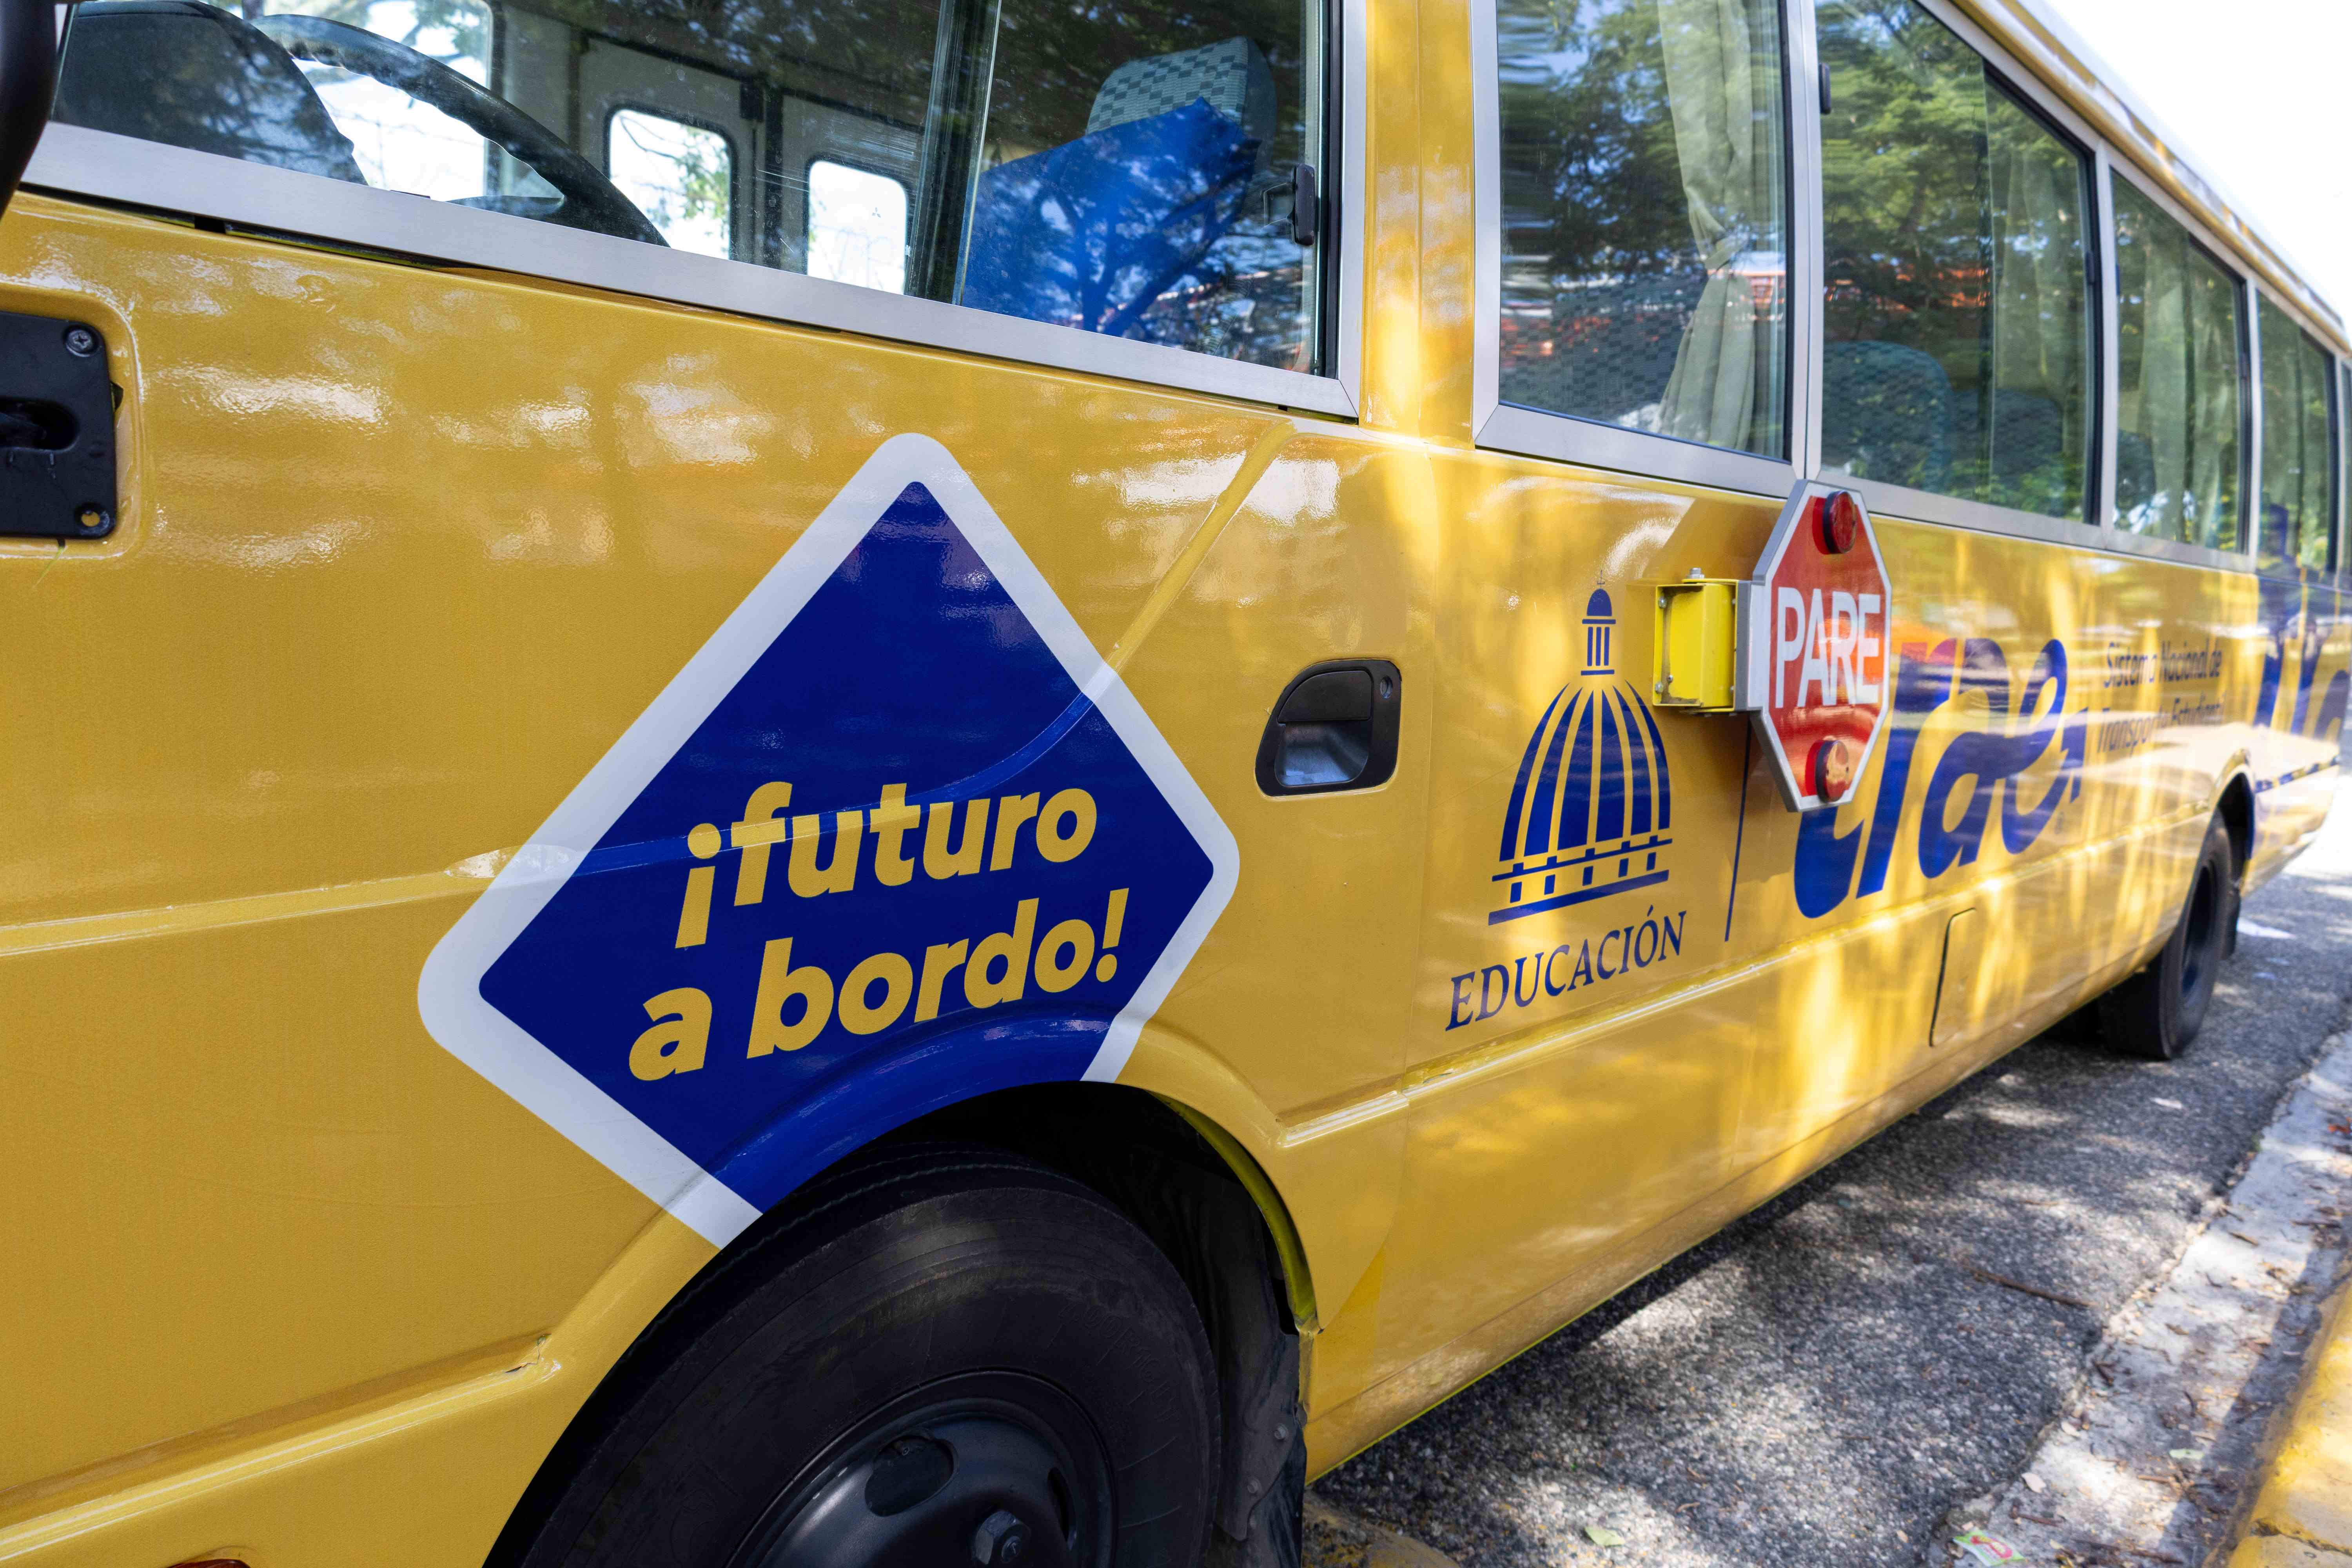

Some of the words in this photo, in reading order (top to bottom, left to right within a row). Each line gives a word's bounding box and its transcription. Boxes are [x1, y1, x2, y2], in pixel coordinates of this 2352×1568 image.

[1775, 586, 1880, 708] PARE
[675, 781, 1097, 948] ¡futuro
[628, 987, 713, 1081] a
[746, 887, 1129, 1059] bordo!
[1445, 904, 1687, 1032] EDUCACIÓN
